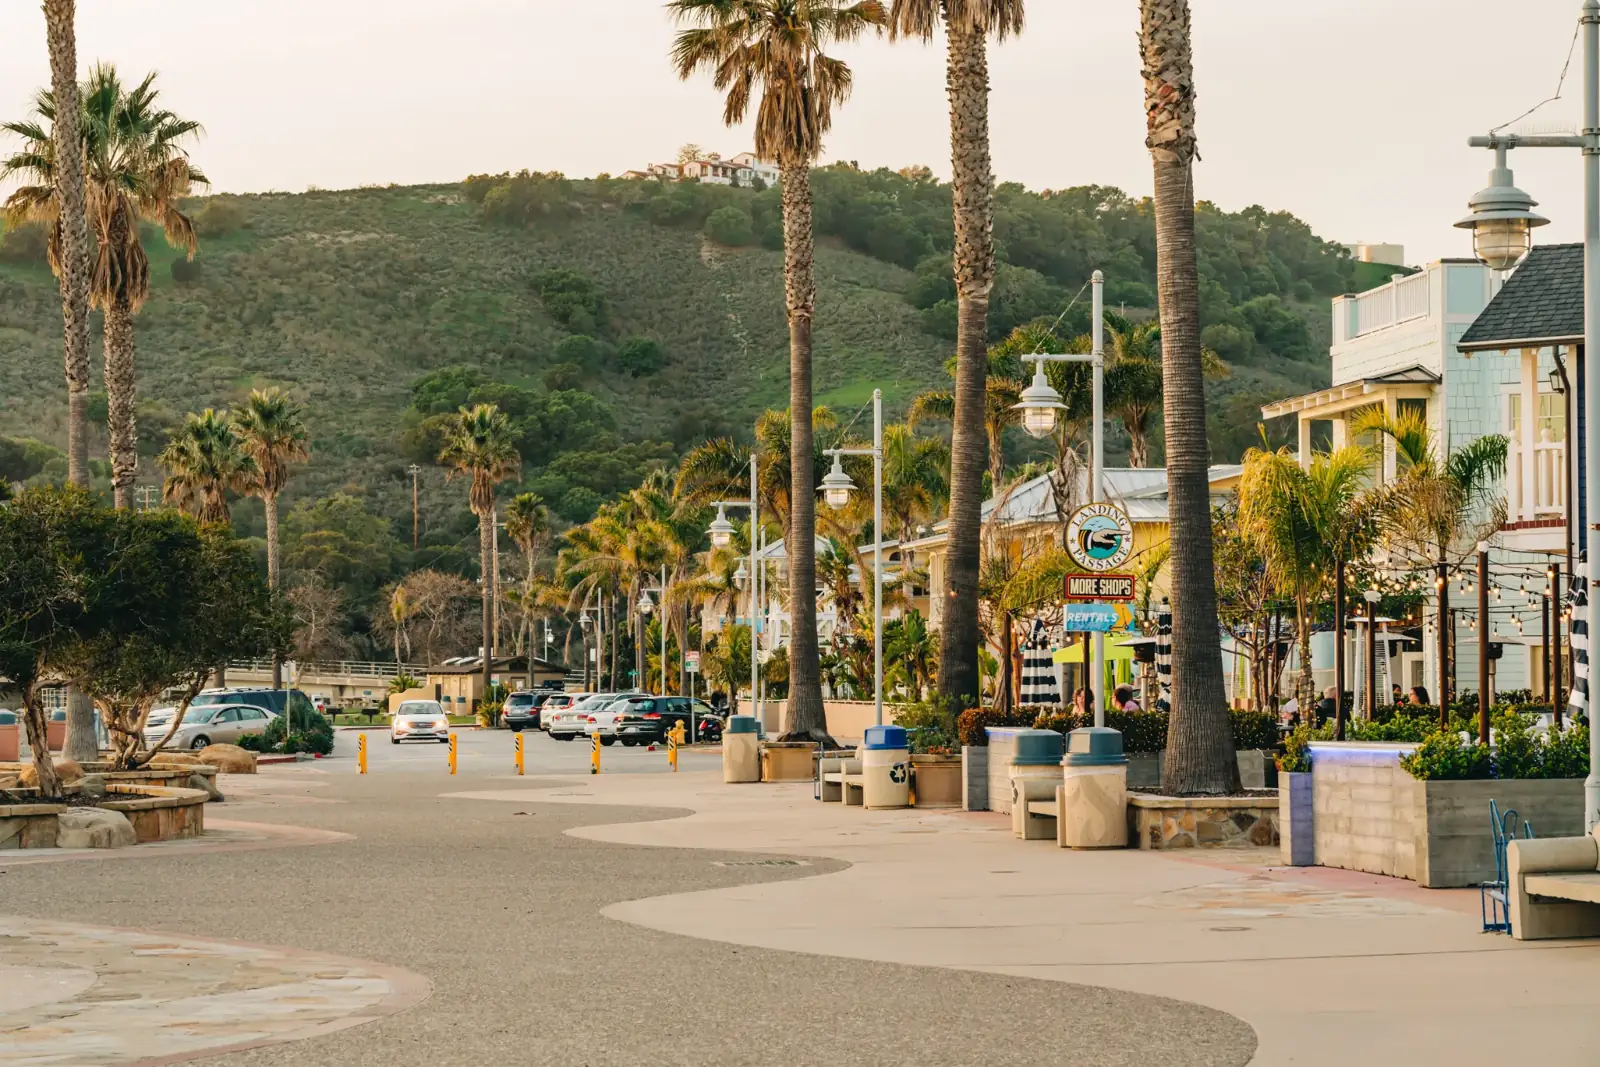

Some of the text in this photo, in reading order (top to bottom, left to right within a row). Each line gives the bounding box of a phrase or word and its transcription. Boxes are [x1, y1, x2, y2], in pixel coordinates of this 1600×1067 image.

[1071, 504, 1128, 528] LANDING
[1072, 546, 1129, 570] PASSAGE
[1070, 578, 1131, 596] MORE SHOPS
[1067, 611, 1119, 622] RENTALS
